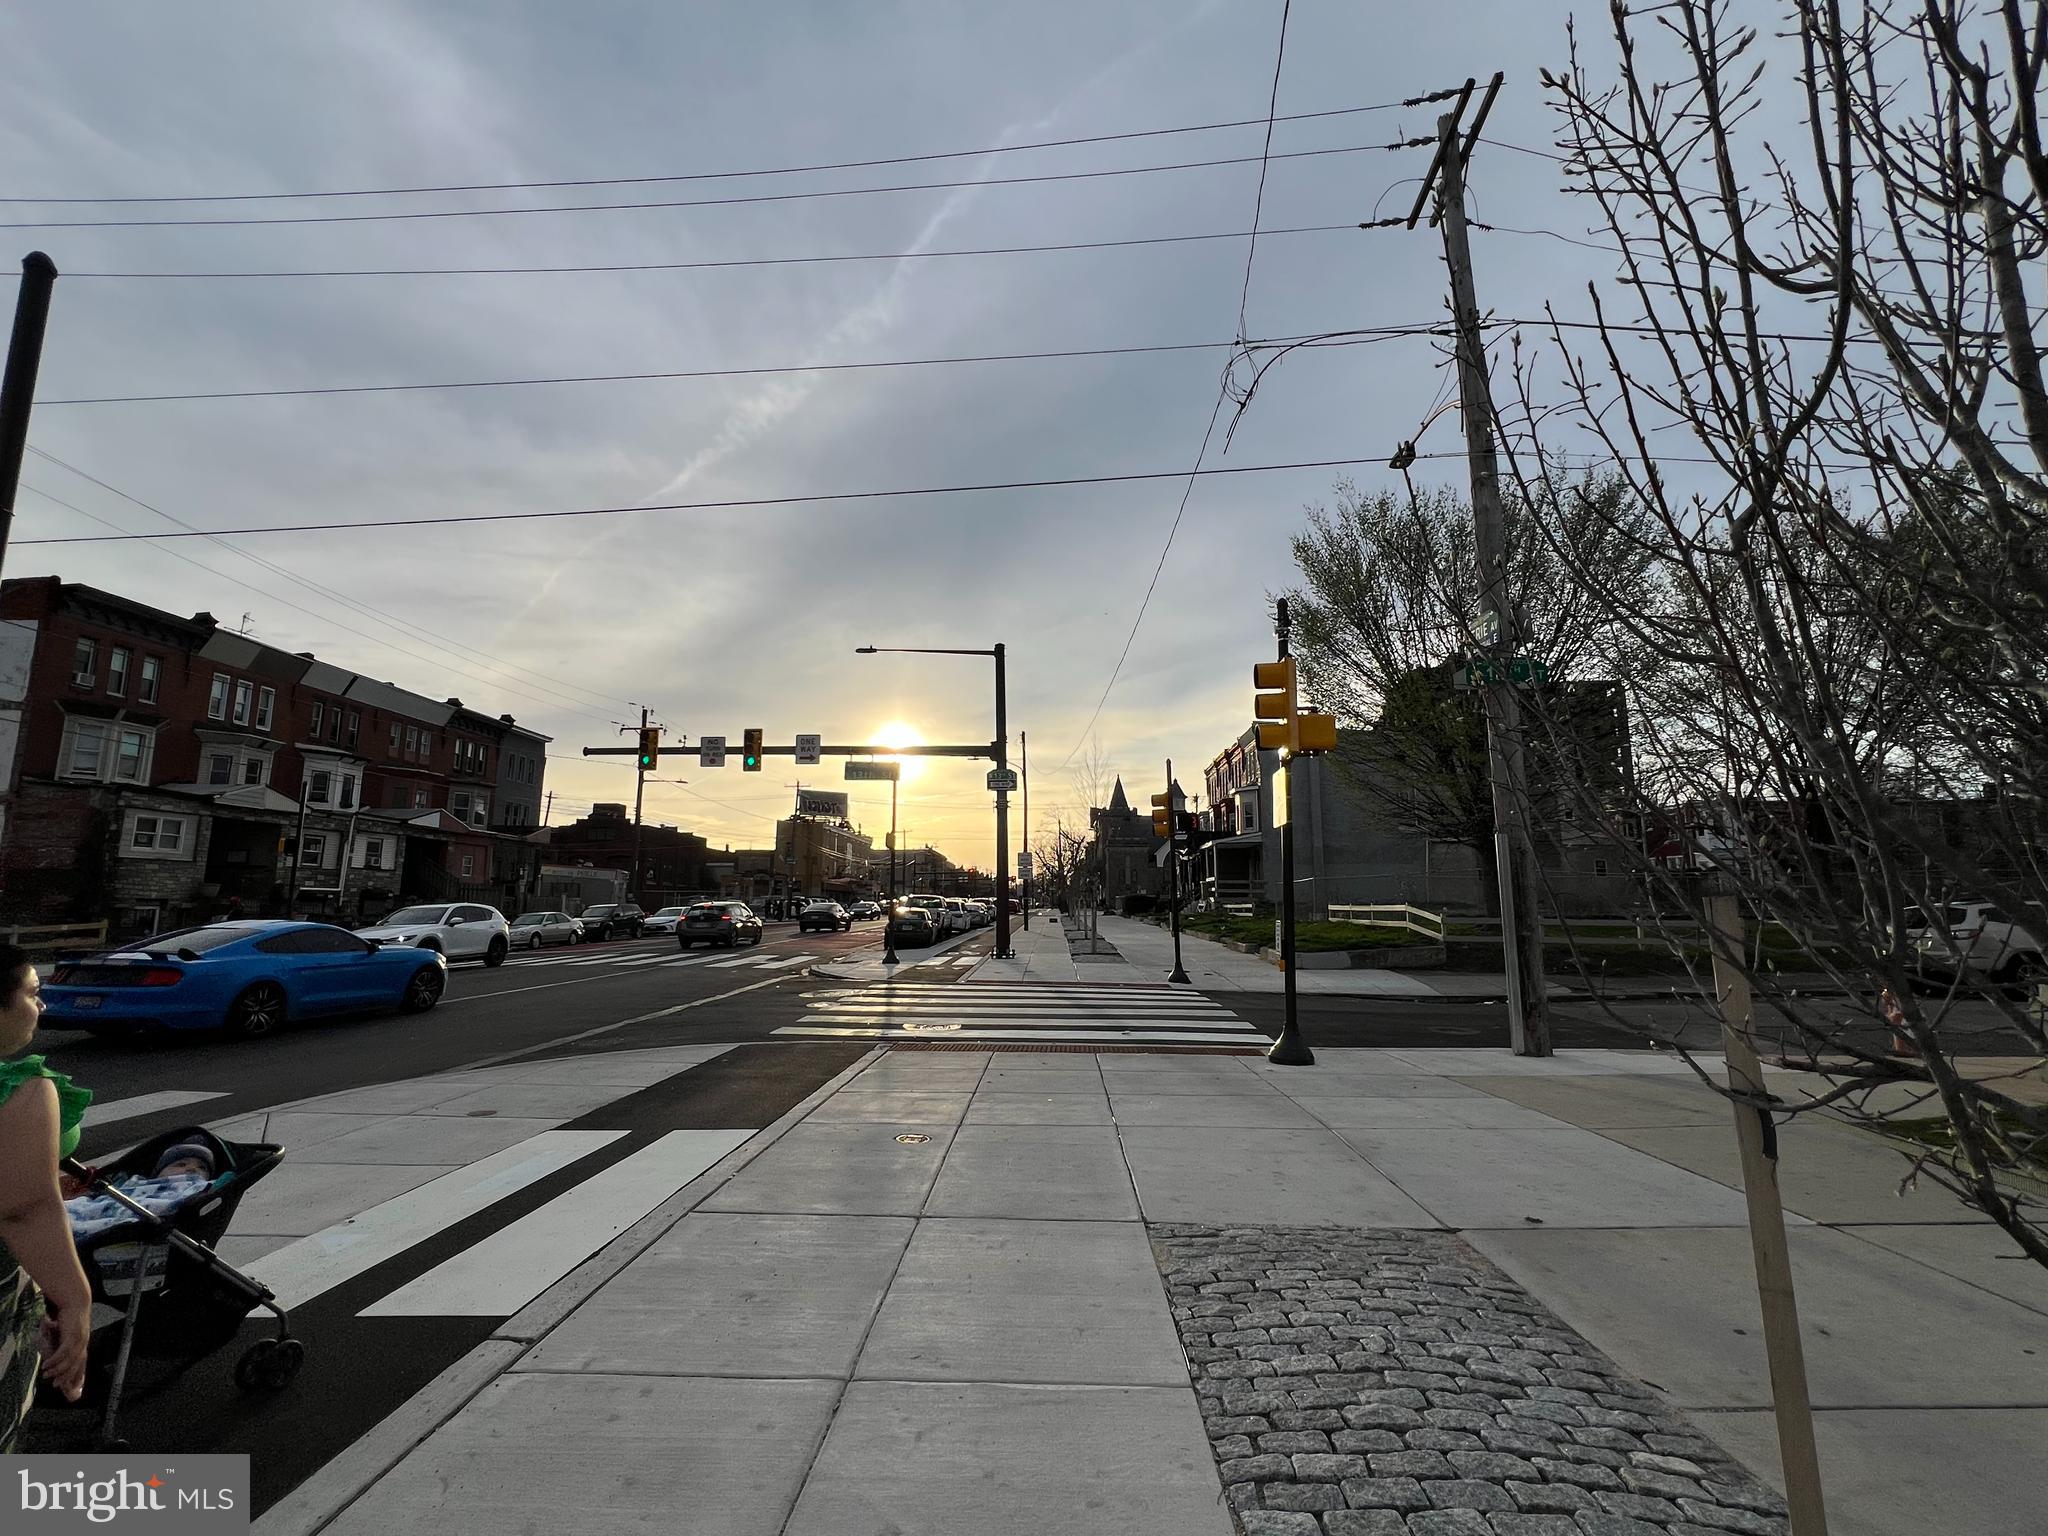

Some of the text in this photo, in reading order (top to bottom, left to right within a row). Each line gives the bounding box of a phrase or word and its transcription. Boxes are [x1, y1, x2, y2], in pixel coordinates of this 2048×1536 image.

[1475, 622, 1489, 640] RIE
[800, 737, 816, 745] ONE
[800, 745, 817, 753] WAY
